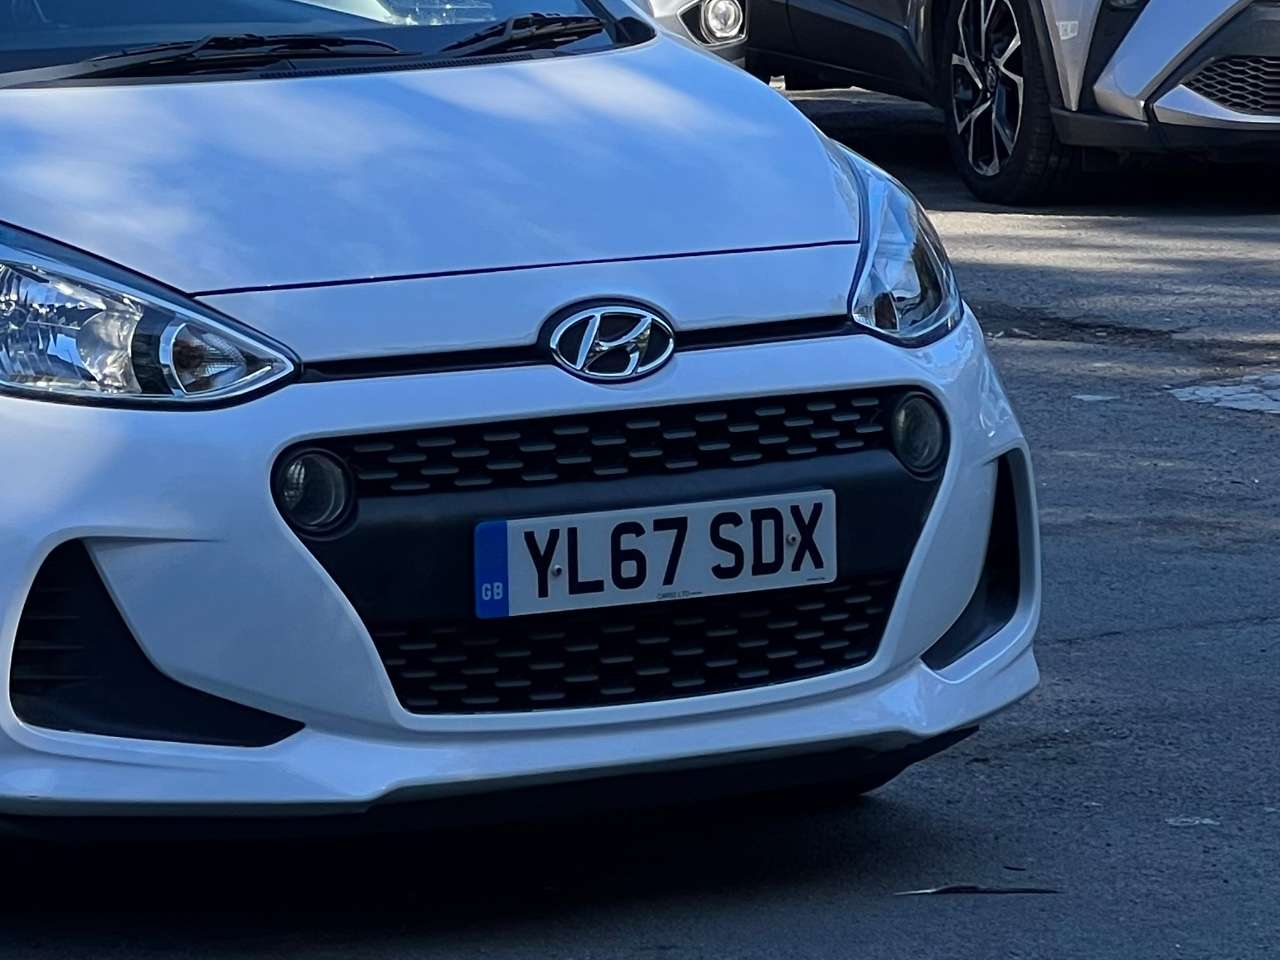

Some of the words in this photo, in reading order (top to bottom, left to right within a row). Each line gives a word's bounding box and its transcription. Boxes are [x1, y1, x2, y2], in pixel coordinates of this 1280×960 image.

[523, 516, 689, 599] YL67
[709, 502, 824, 580] SDX
[481, 582, 503, 601] GB
